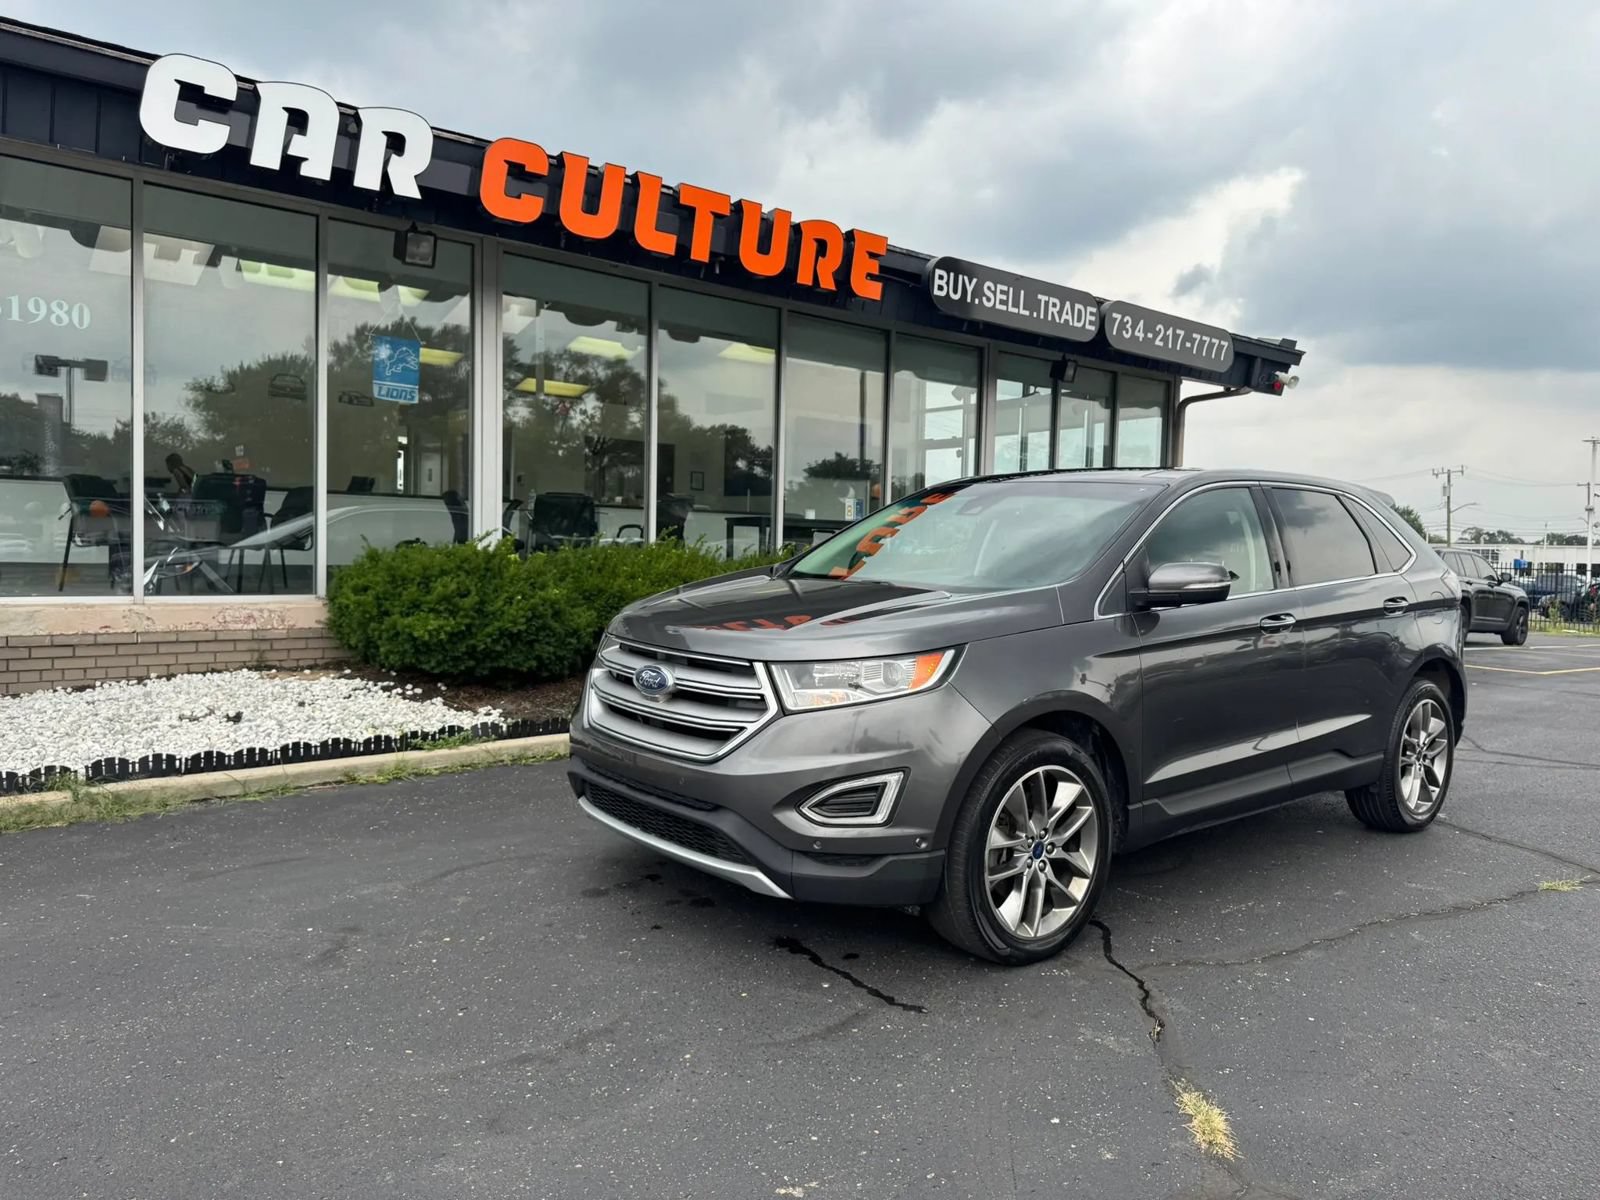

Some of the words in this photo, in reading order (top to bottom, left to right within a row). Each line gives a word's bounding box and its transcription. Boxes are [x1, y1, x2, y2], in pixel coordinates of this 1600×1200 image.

[140, 53, 433, 199] CAR
[480, 137, 888, 300] CULTURE
[0, 295, 91, 329] 1980
[1111, 312, 1229, 361] 734-217-7777
[639, 670, 661, 688] Ford
